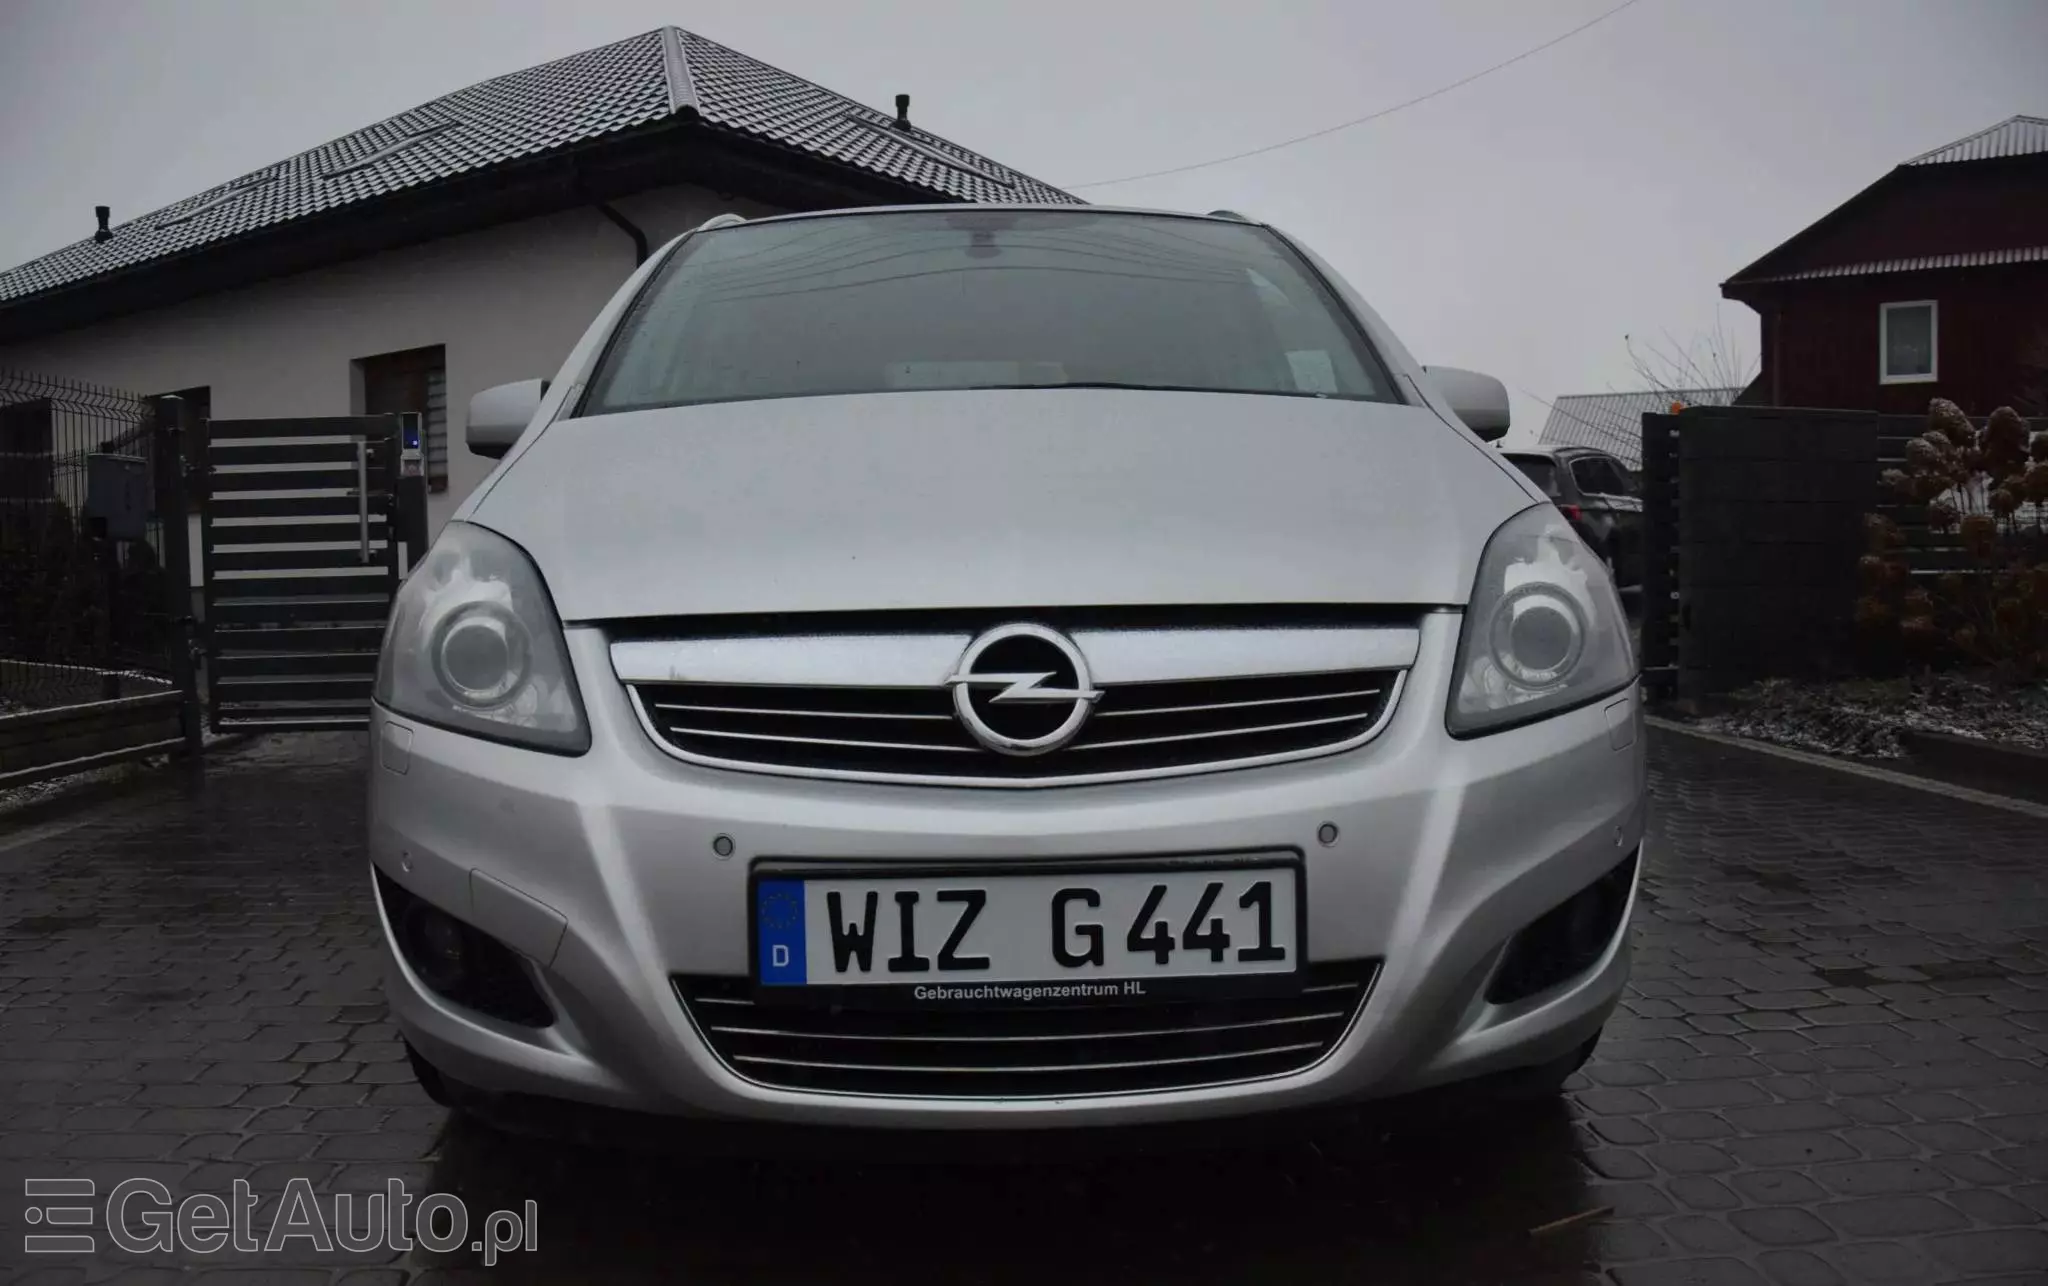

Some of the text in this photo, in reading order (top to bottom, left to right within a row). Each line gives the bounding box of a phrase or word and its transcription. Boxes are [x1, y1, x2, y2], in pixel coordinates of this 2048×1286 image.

[826, 889, 990, 973] WIZ
[772, 945, 789, 967] D
[914, 982, 1146, 1001] Gebrauchtwagenzentrum HL
